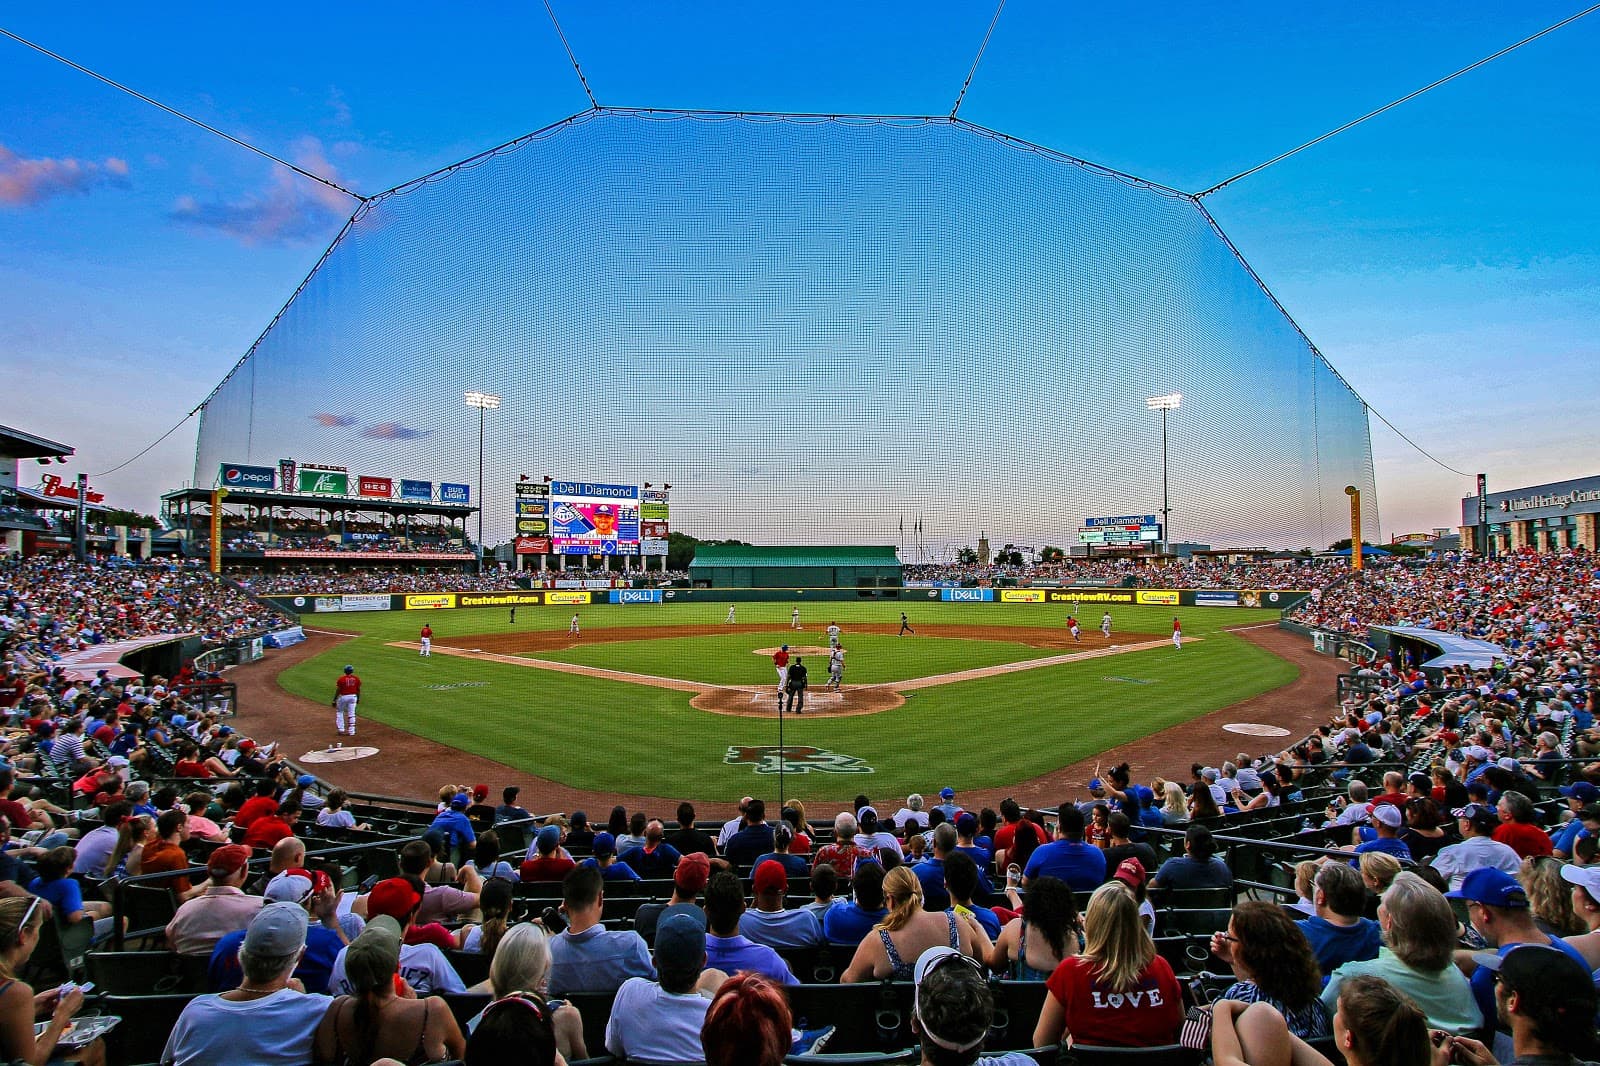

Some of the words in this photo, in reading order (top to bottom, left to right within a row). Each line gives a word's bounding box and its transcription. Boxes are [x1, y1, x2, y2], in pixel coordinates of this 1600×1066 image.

[242, 473, 272, 483] pepsi
[559, 482, 581, 493] Dell
[585, 484, 632, 497] Diamond
[444, 492, 467, 500] LIGHT
[1509, 495, 1534, 511] United
[1535, 492, 1571, 509] Heritage
[1093, 518, 1108, 526] Dell
[1111, 516, 1145, 525] Diamond
[624, 591, 650, 601] DELL
[955, 590, 981, 600] DELL
[1051, 593, 1132, 602] CrestviewRV.com
[462, 596, 539, 605] CrestviewRV.com
